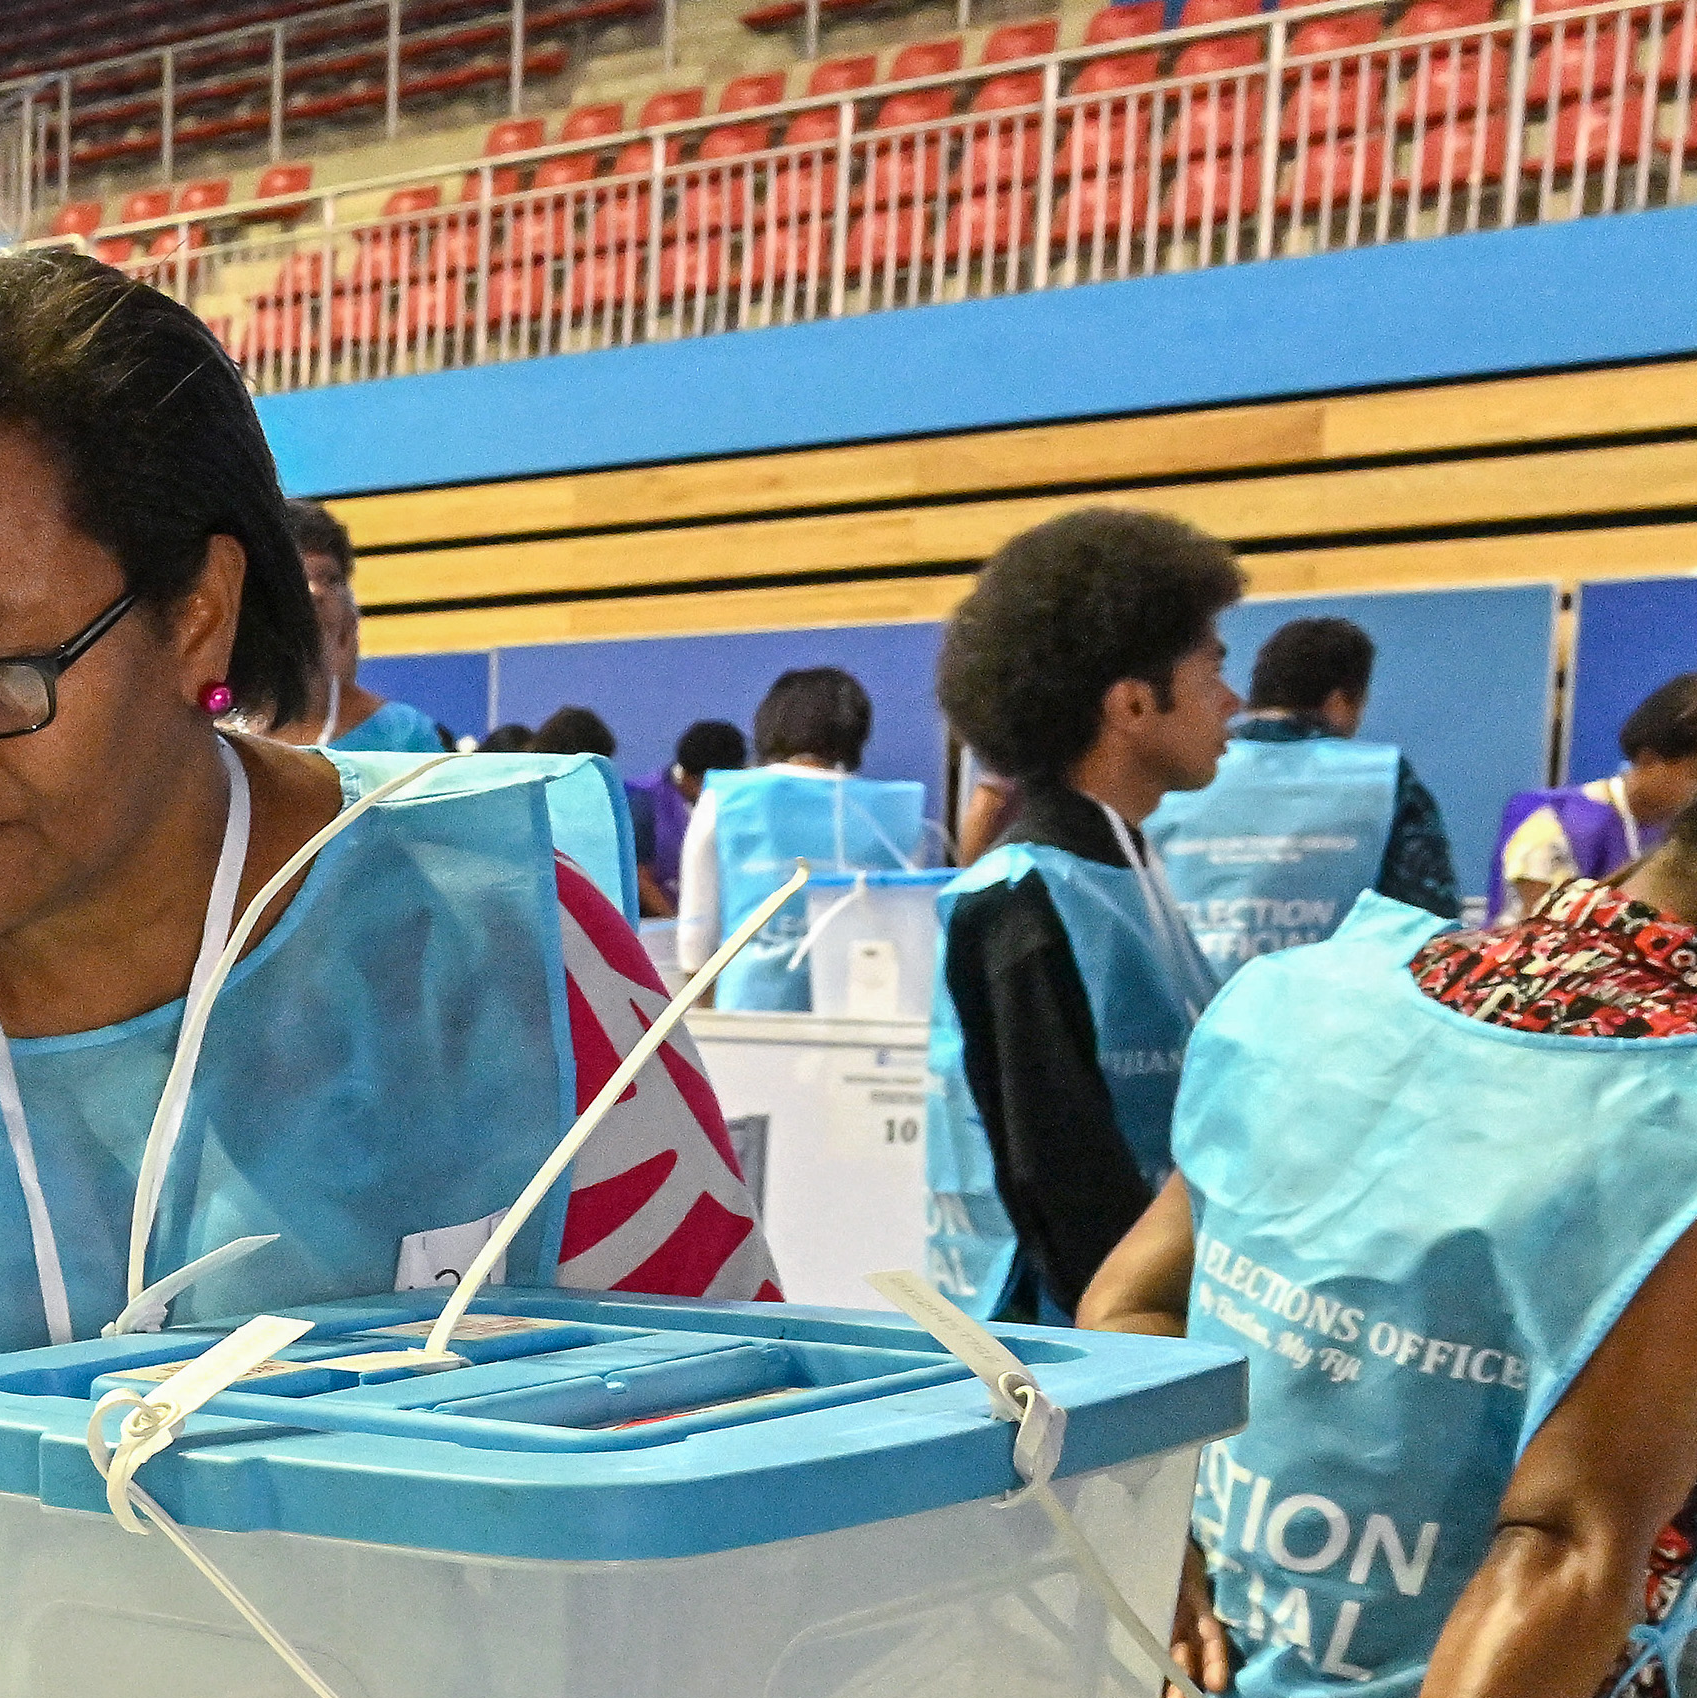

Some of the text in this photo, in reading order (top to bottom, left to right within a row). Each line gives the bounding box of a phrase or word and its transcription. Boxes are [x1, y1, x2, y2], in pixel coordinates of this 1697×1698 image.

[885, 1118, 917, 1144] 10
[1205, 1239, 1529, 1390] ELECTIONS OFFICE
